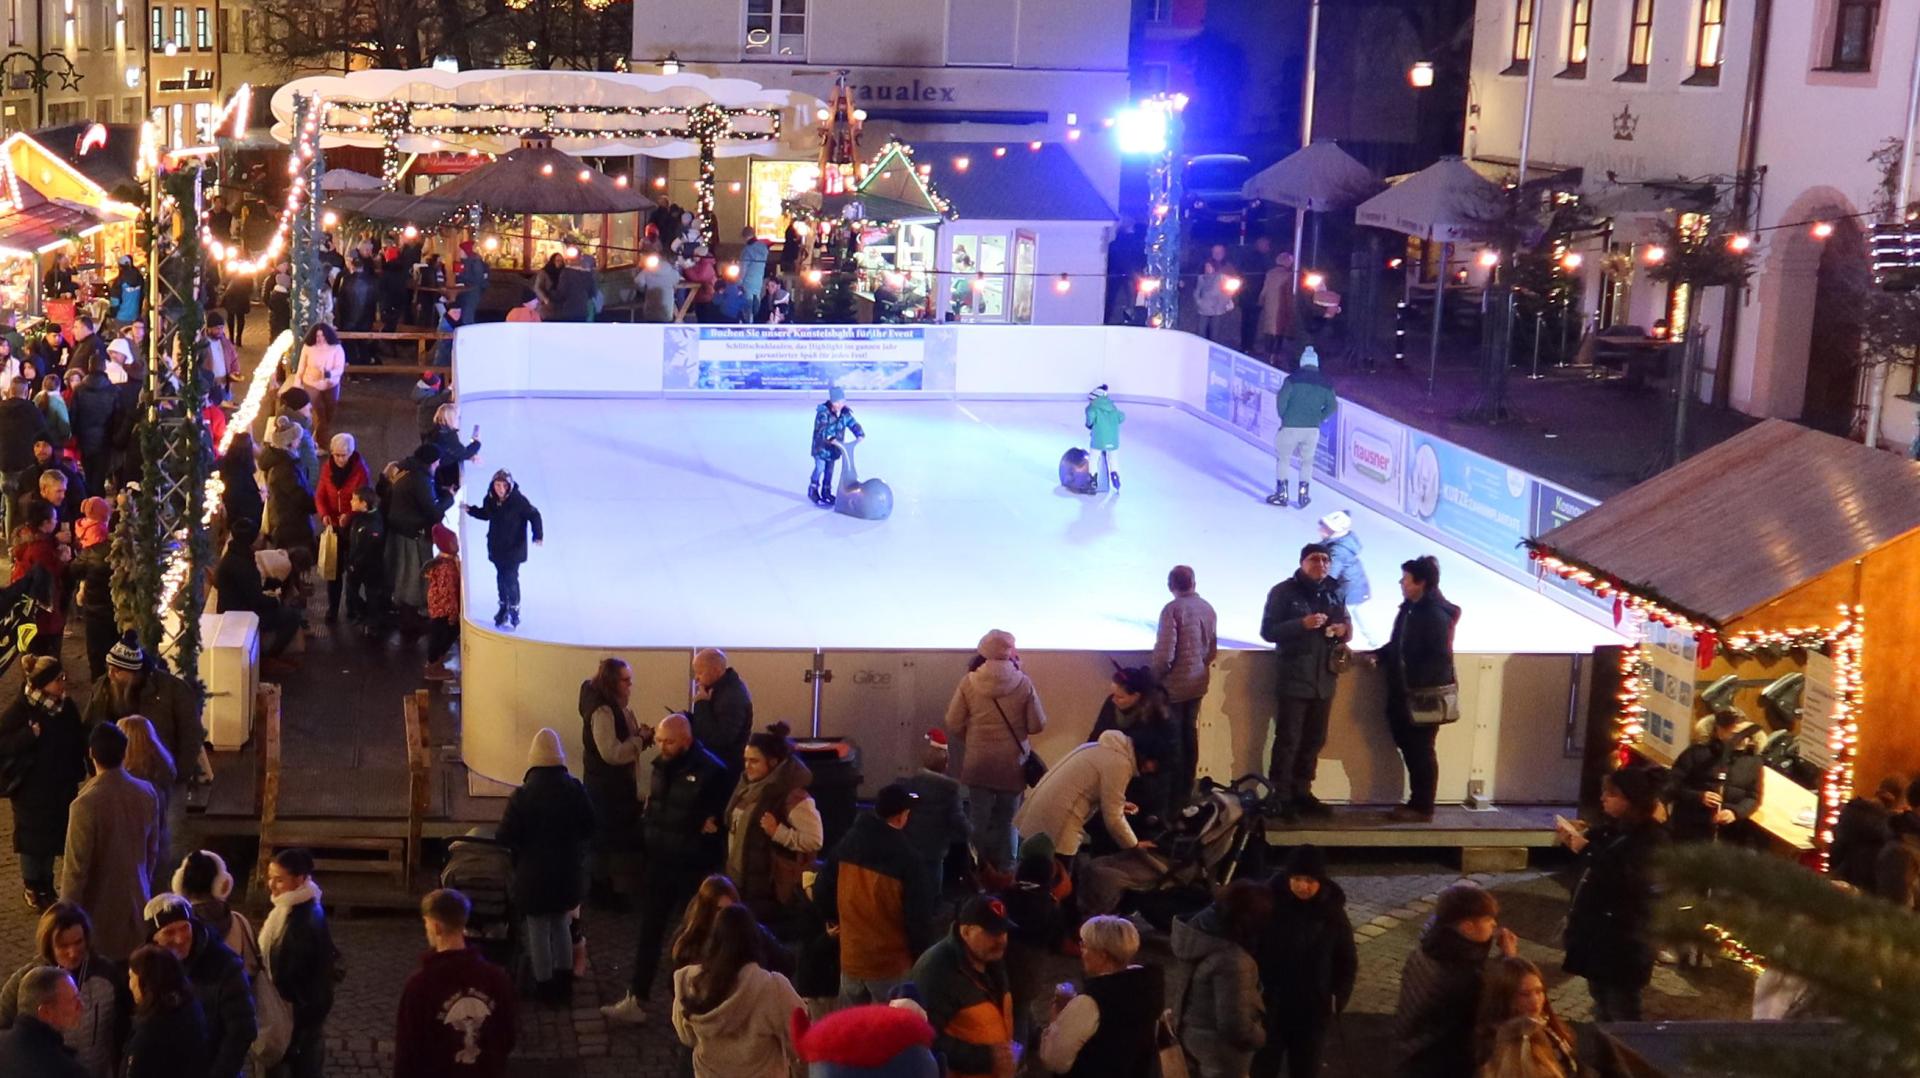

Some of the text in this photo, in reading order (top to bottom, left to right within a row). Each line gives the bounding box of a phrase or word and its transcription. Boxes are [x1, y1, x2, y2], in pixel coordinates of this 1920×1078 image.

[711, 329, 745, 337] Buchen
[746, 329, 760, 337] Sie
[761, 329, 792, 337] unsere
[872, 329, 887, 337] Ihr
[888, 329, 914, 337] Event
[1353, 440, 1390, 471] hausner
